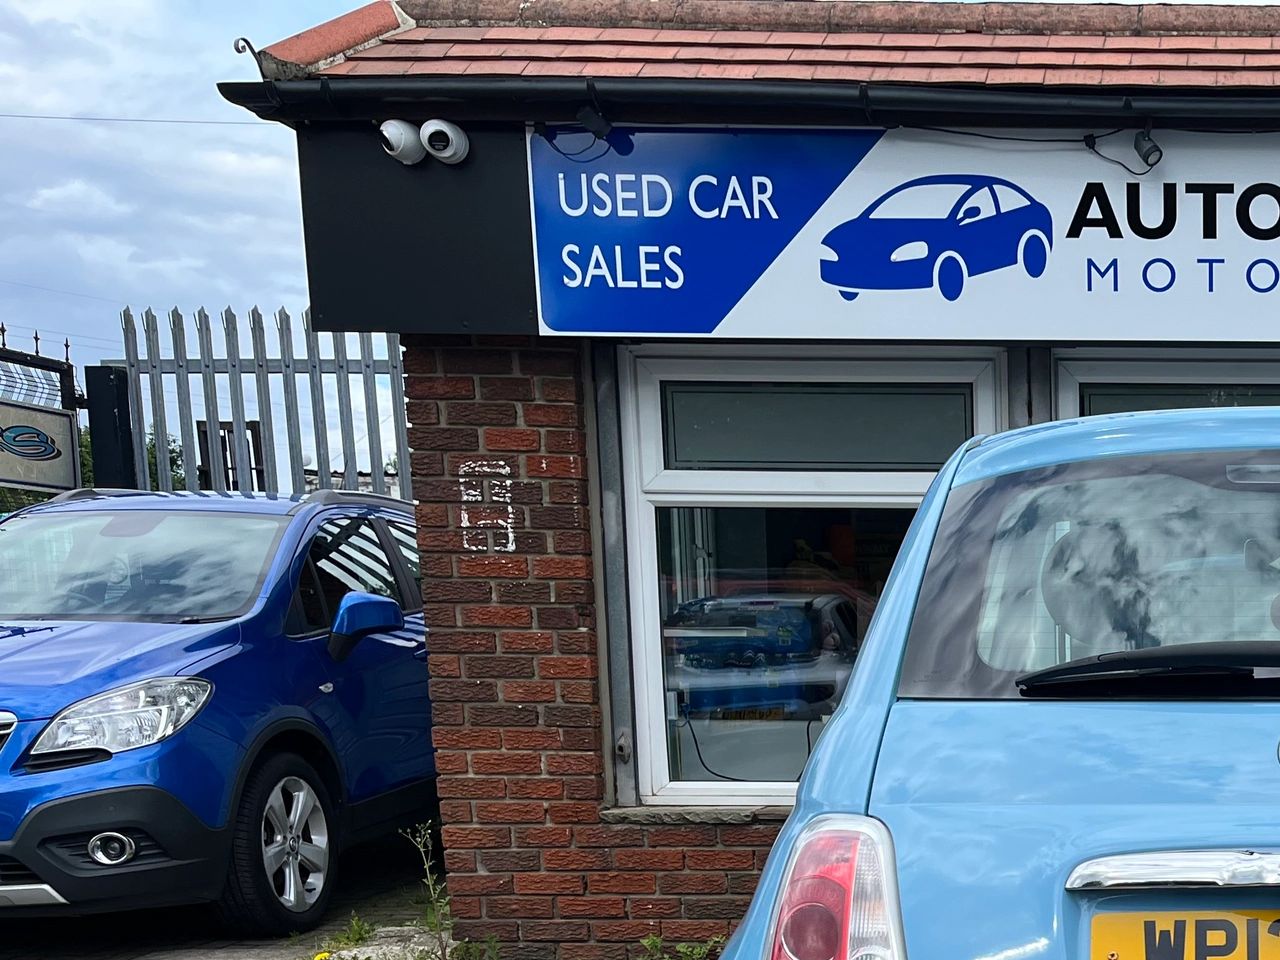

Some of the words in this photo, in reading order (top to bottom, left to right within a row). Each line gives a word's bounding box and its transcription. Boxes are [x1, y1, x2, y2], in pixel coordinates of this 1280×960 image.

[557, 173, 672, 218] USED
[687, 175, 779, 220] CAR
[561, 244, 684, 289] SALES
